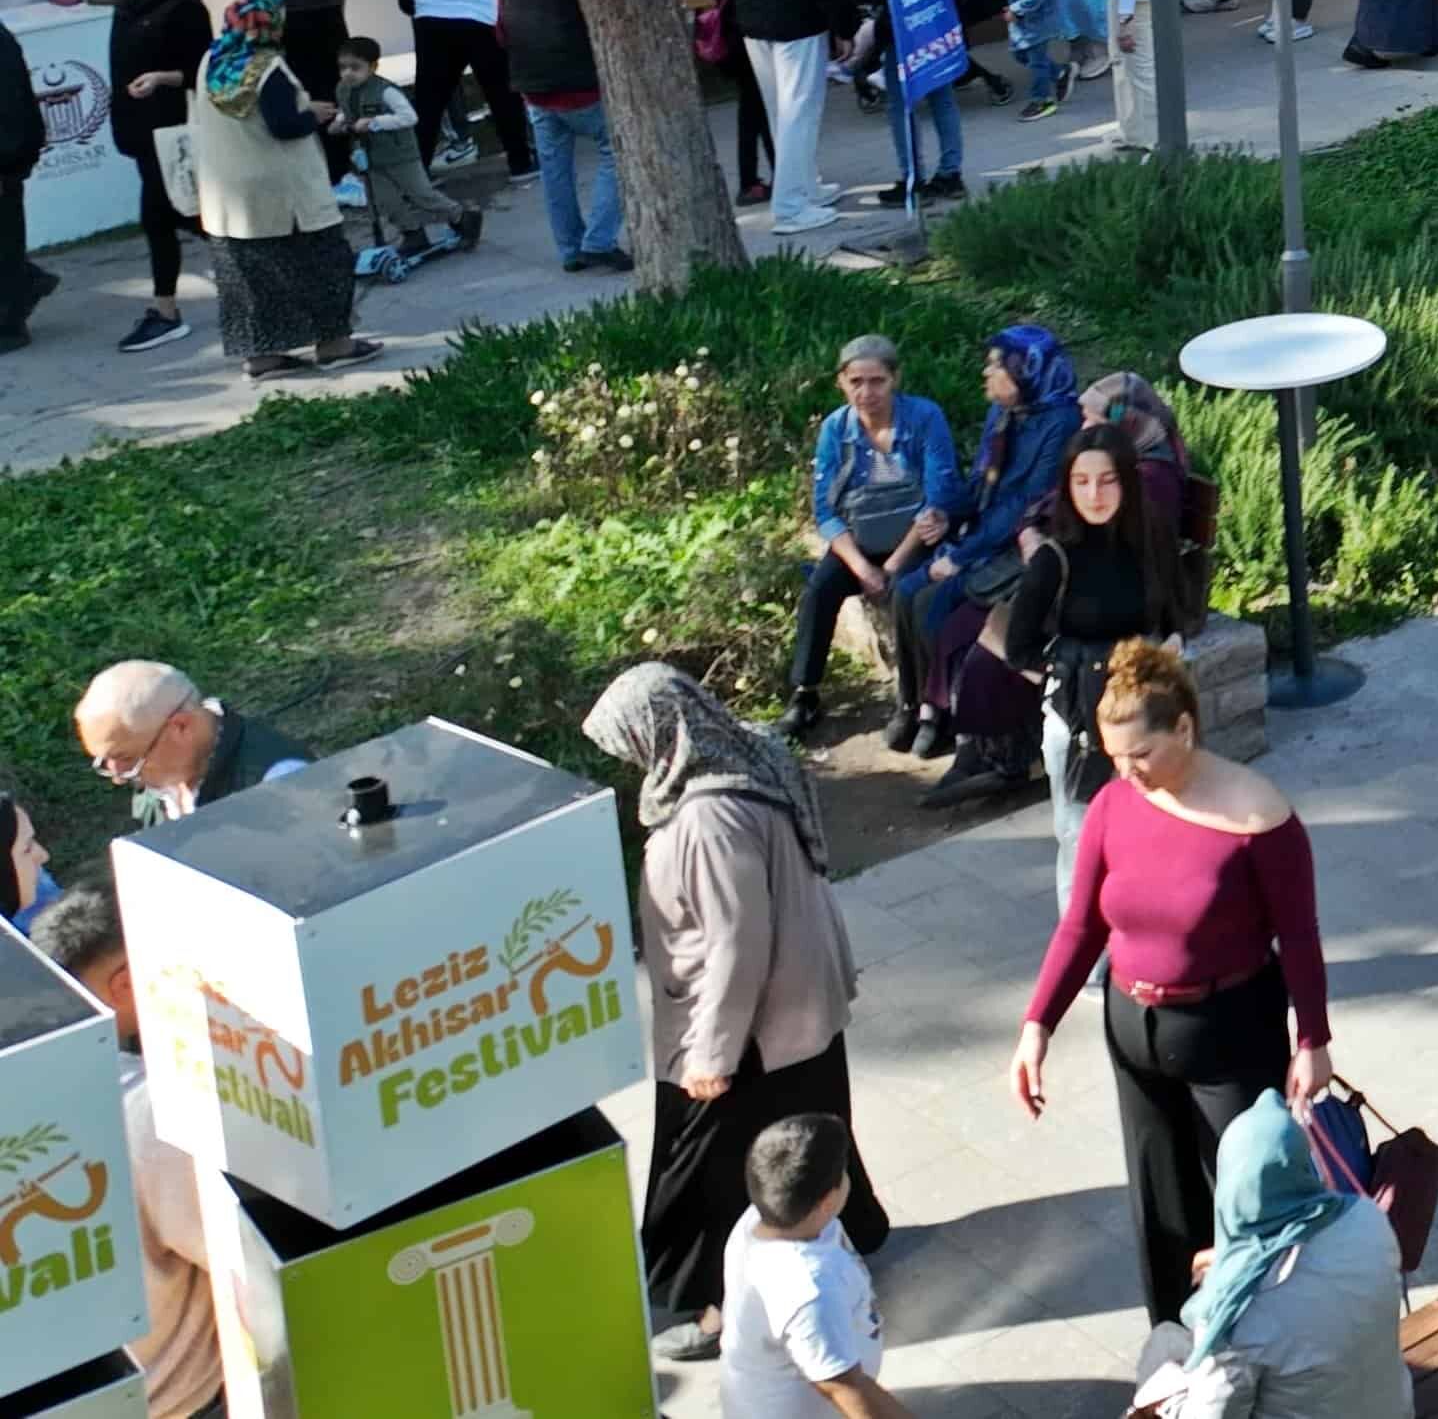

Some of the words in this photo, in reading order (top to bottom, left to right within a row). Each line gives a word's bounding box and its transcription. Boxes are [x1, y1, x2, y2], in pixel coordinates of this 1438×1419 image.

[338, 979, 519, 1087] Akhisar
[361, 943, 491, 1027] Leziz
[377, 980, 623, 1130] Festivali
